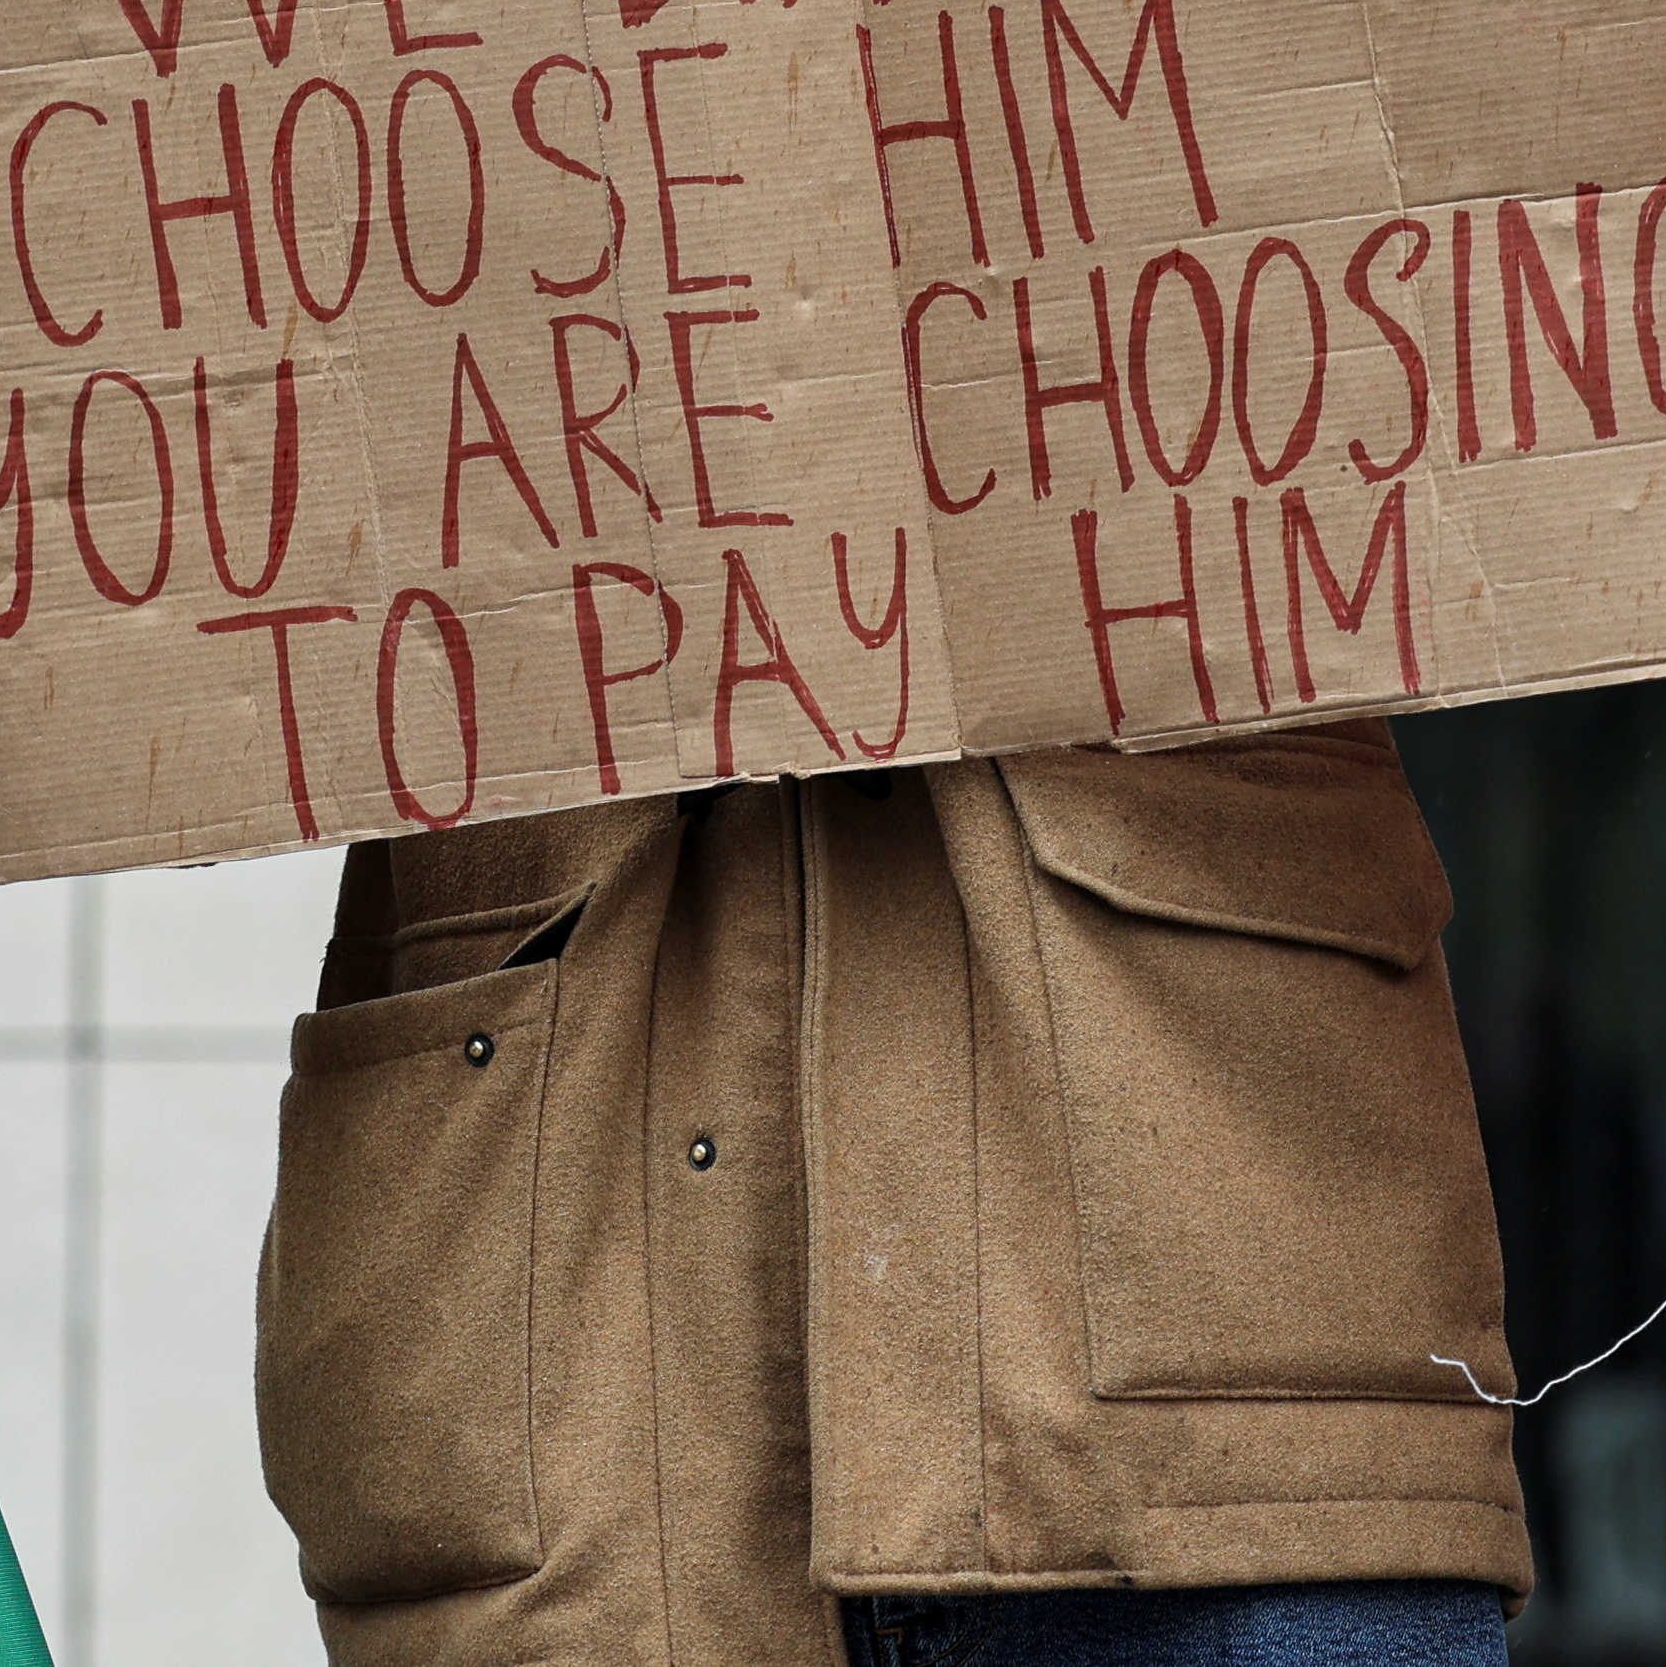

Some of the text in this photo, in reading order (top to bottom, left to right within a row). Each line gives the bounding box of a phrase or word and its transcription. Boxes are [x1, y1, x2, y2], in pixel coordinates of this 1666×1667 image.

[10, 43, 751, 347] CHOOSE
[442, 308, 795, 567] ARE
[197, 480, 1420, 840] TO PAY HIM
